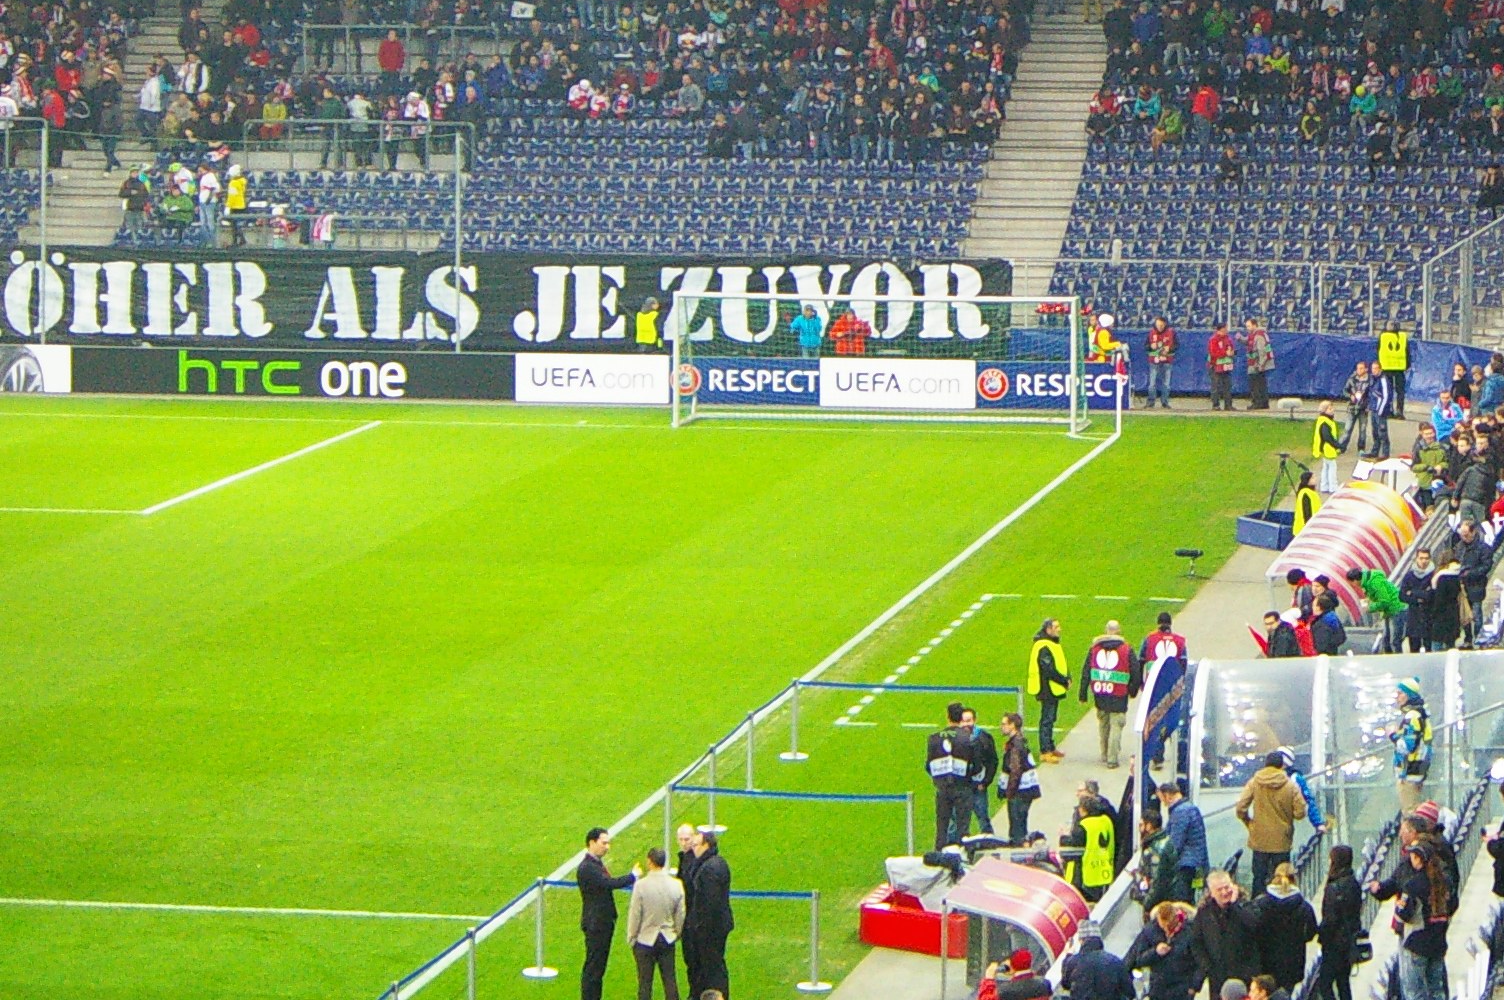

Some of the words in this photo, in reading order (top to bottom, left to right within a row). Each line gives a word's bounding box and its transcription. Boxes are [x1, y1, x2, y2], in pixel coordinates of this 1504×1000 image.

[4, 250, 273, 338] ÖHER
[304, 266, 479, 342] ALS
[513, 266, 626, 342] JE
[661, 263, 990, 344] ZUVOR
[320, 360, 408, 397] one
[708, 368, 820, 393] RESPECT
